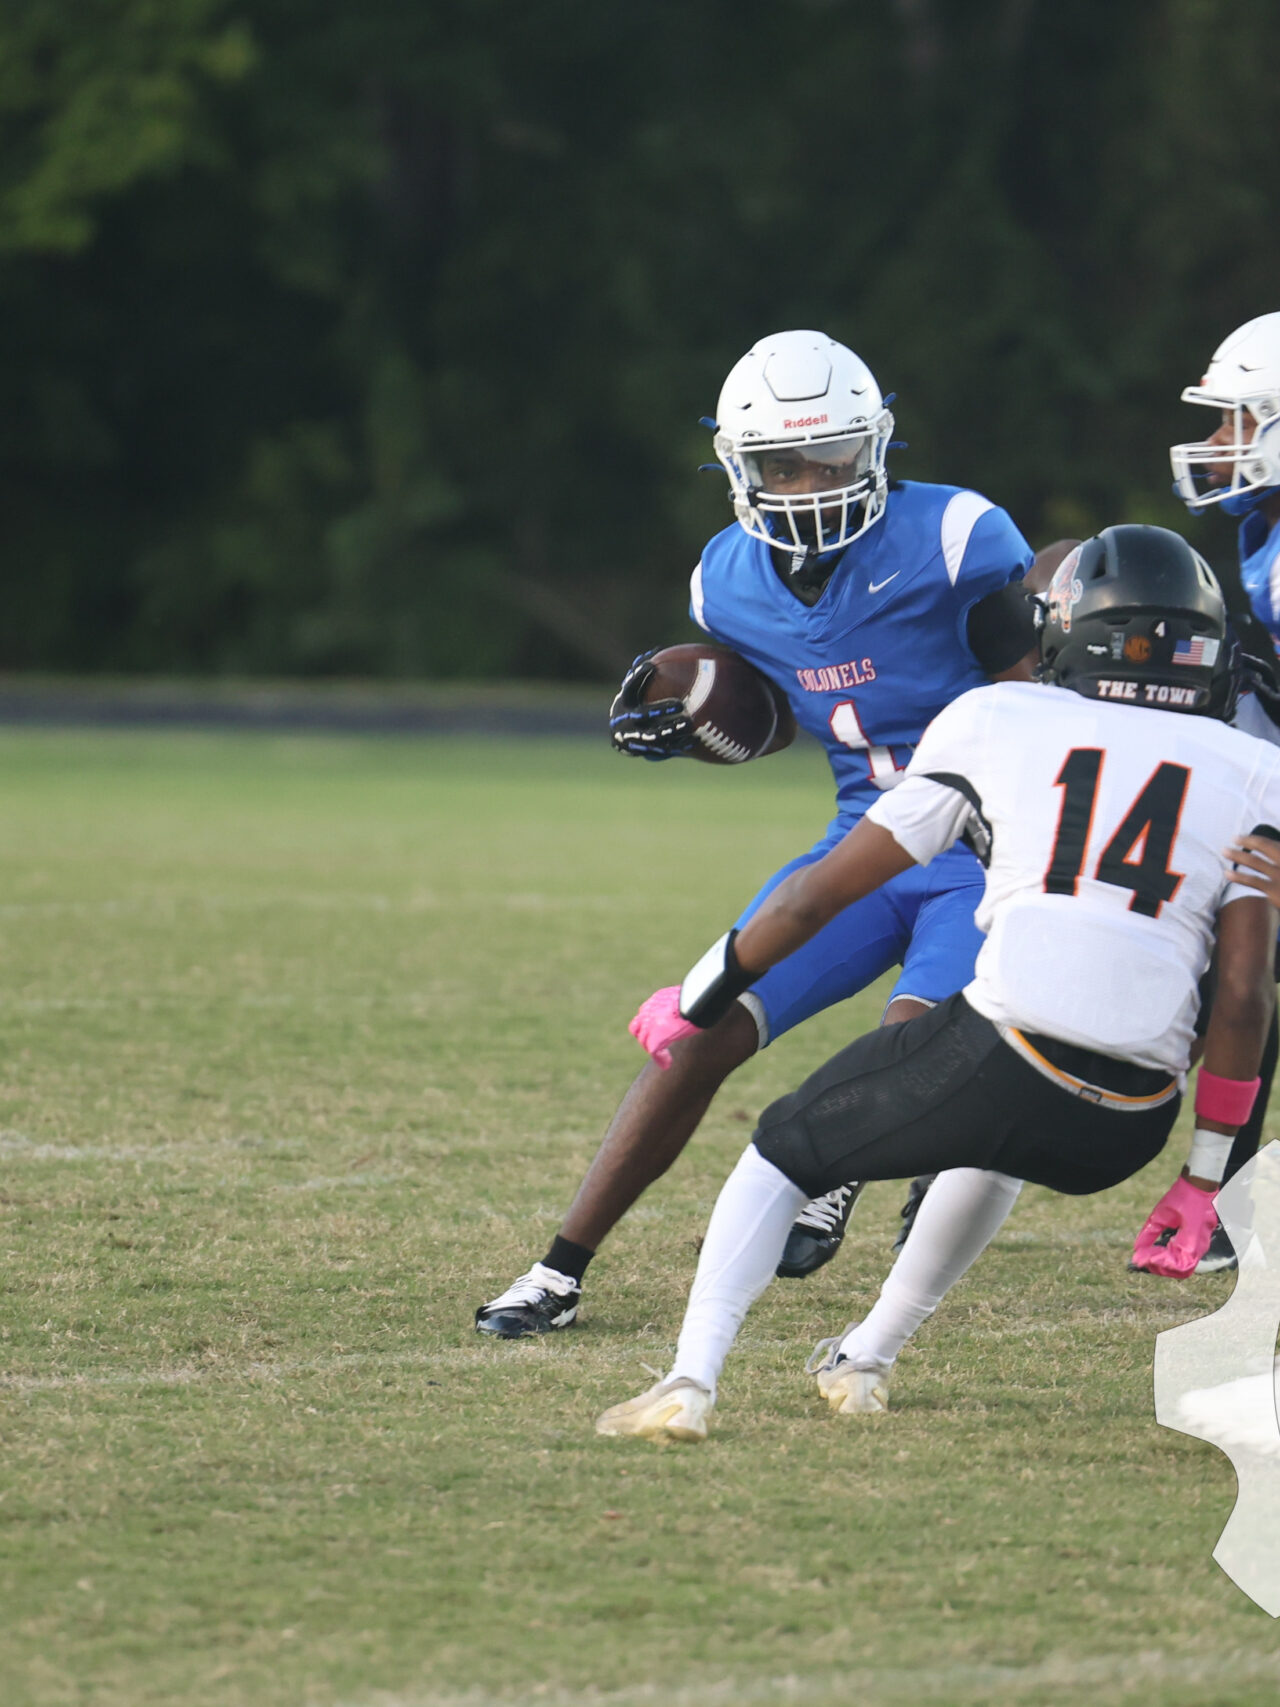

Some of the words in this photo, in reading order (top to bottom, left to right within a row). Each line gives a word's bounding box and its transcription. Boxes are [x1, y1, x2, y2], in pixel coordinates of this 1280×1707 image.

[783, 413, 828, 429] Riddell
[1154, 621, 1166, 637] 4
[1097, 680, 1138, 699] THE
[1145, 684, 1197, 705] TOWN
[1042, 746, 1193, 920] 14
